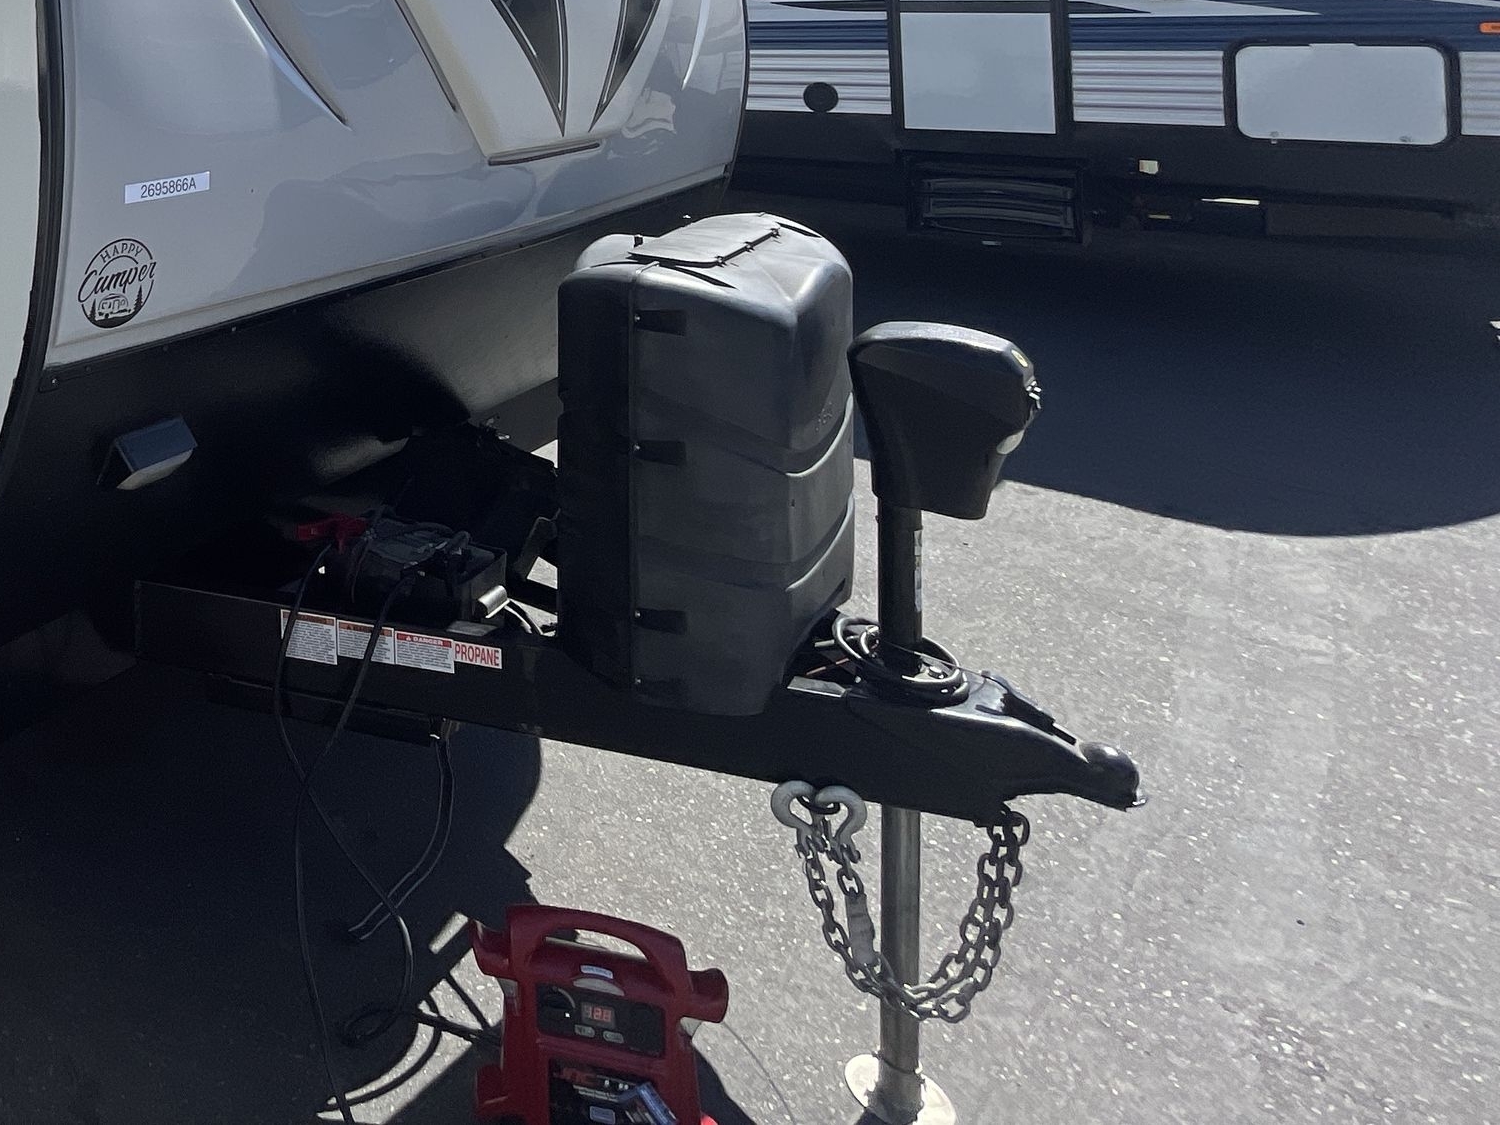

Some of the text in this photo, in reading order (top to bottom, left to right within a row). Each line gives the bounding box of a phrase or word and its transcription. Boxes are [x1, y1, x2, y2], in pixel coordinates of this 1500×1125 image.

[140, 177, 197, 198] 2695866A
[100, 243, 143, 263] HAPPY
[78, 260, 157, 303] Camper
[413, 636, 443, 646] DANGER
[455, 644, 499, 666] PROPANE
